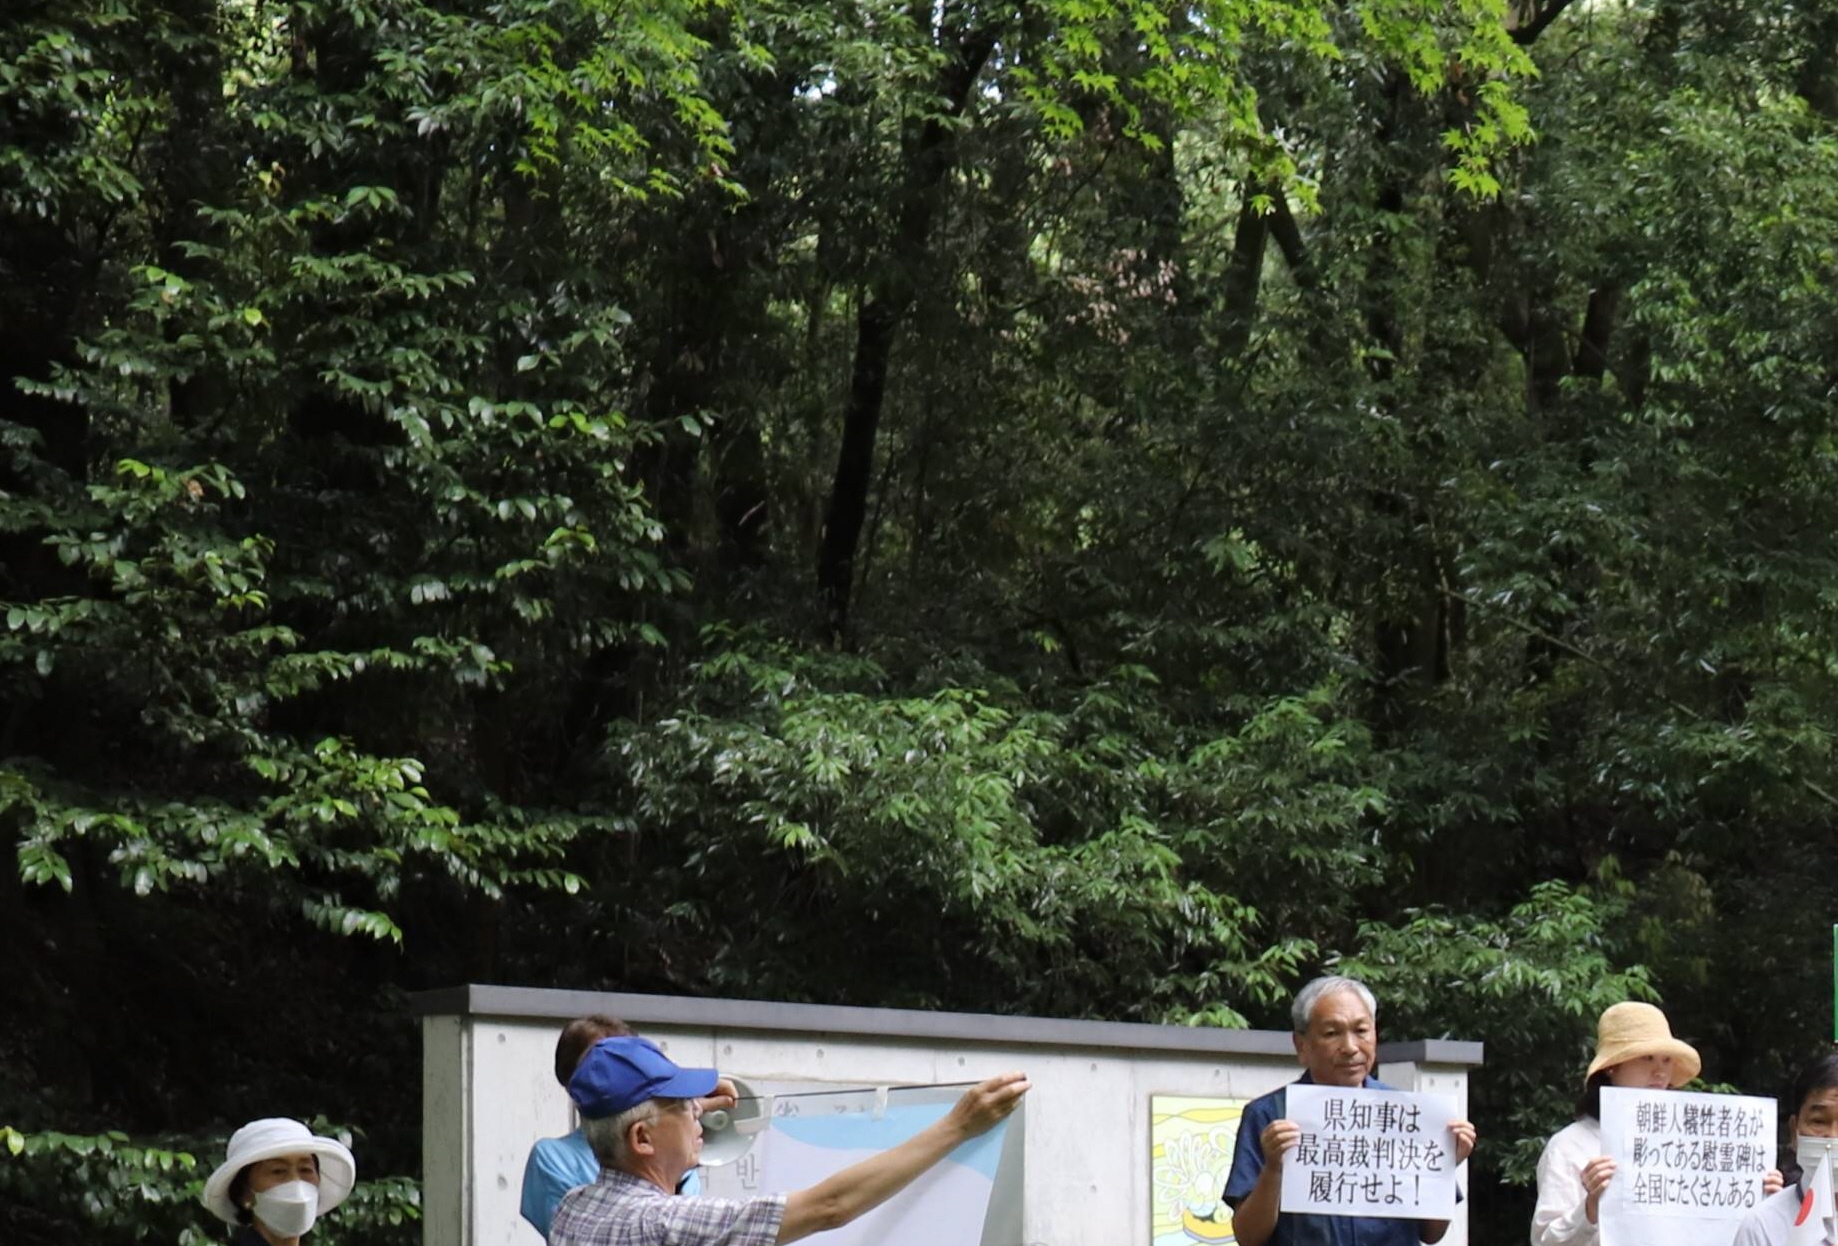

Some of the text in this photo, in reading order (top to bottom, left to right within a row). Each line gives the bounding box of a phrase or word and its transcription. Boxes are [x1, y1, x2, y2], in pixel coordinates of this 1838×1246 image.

[1323, 1099, 1421, 1133] 県知事は
[1636, 1101, 1764, 1139] 朝鮮人犠牲者名が
[1296, 1134, 1445, 1172] 最高裁判決を
[1633, 1137, 1766, 1173] 彫ってある慰霊碑は
[1308, 1171, 1420, 1206] 履行せよ！
[1633, 1172, 1756, 1208] 全国にたくさんある
